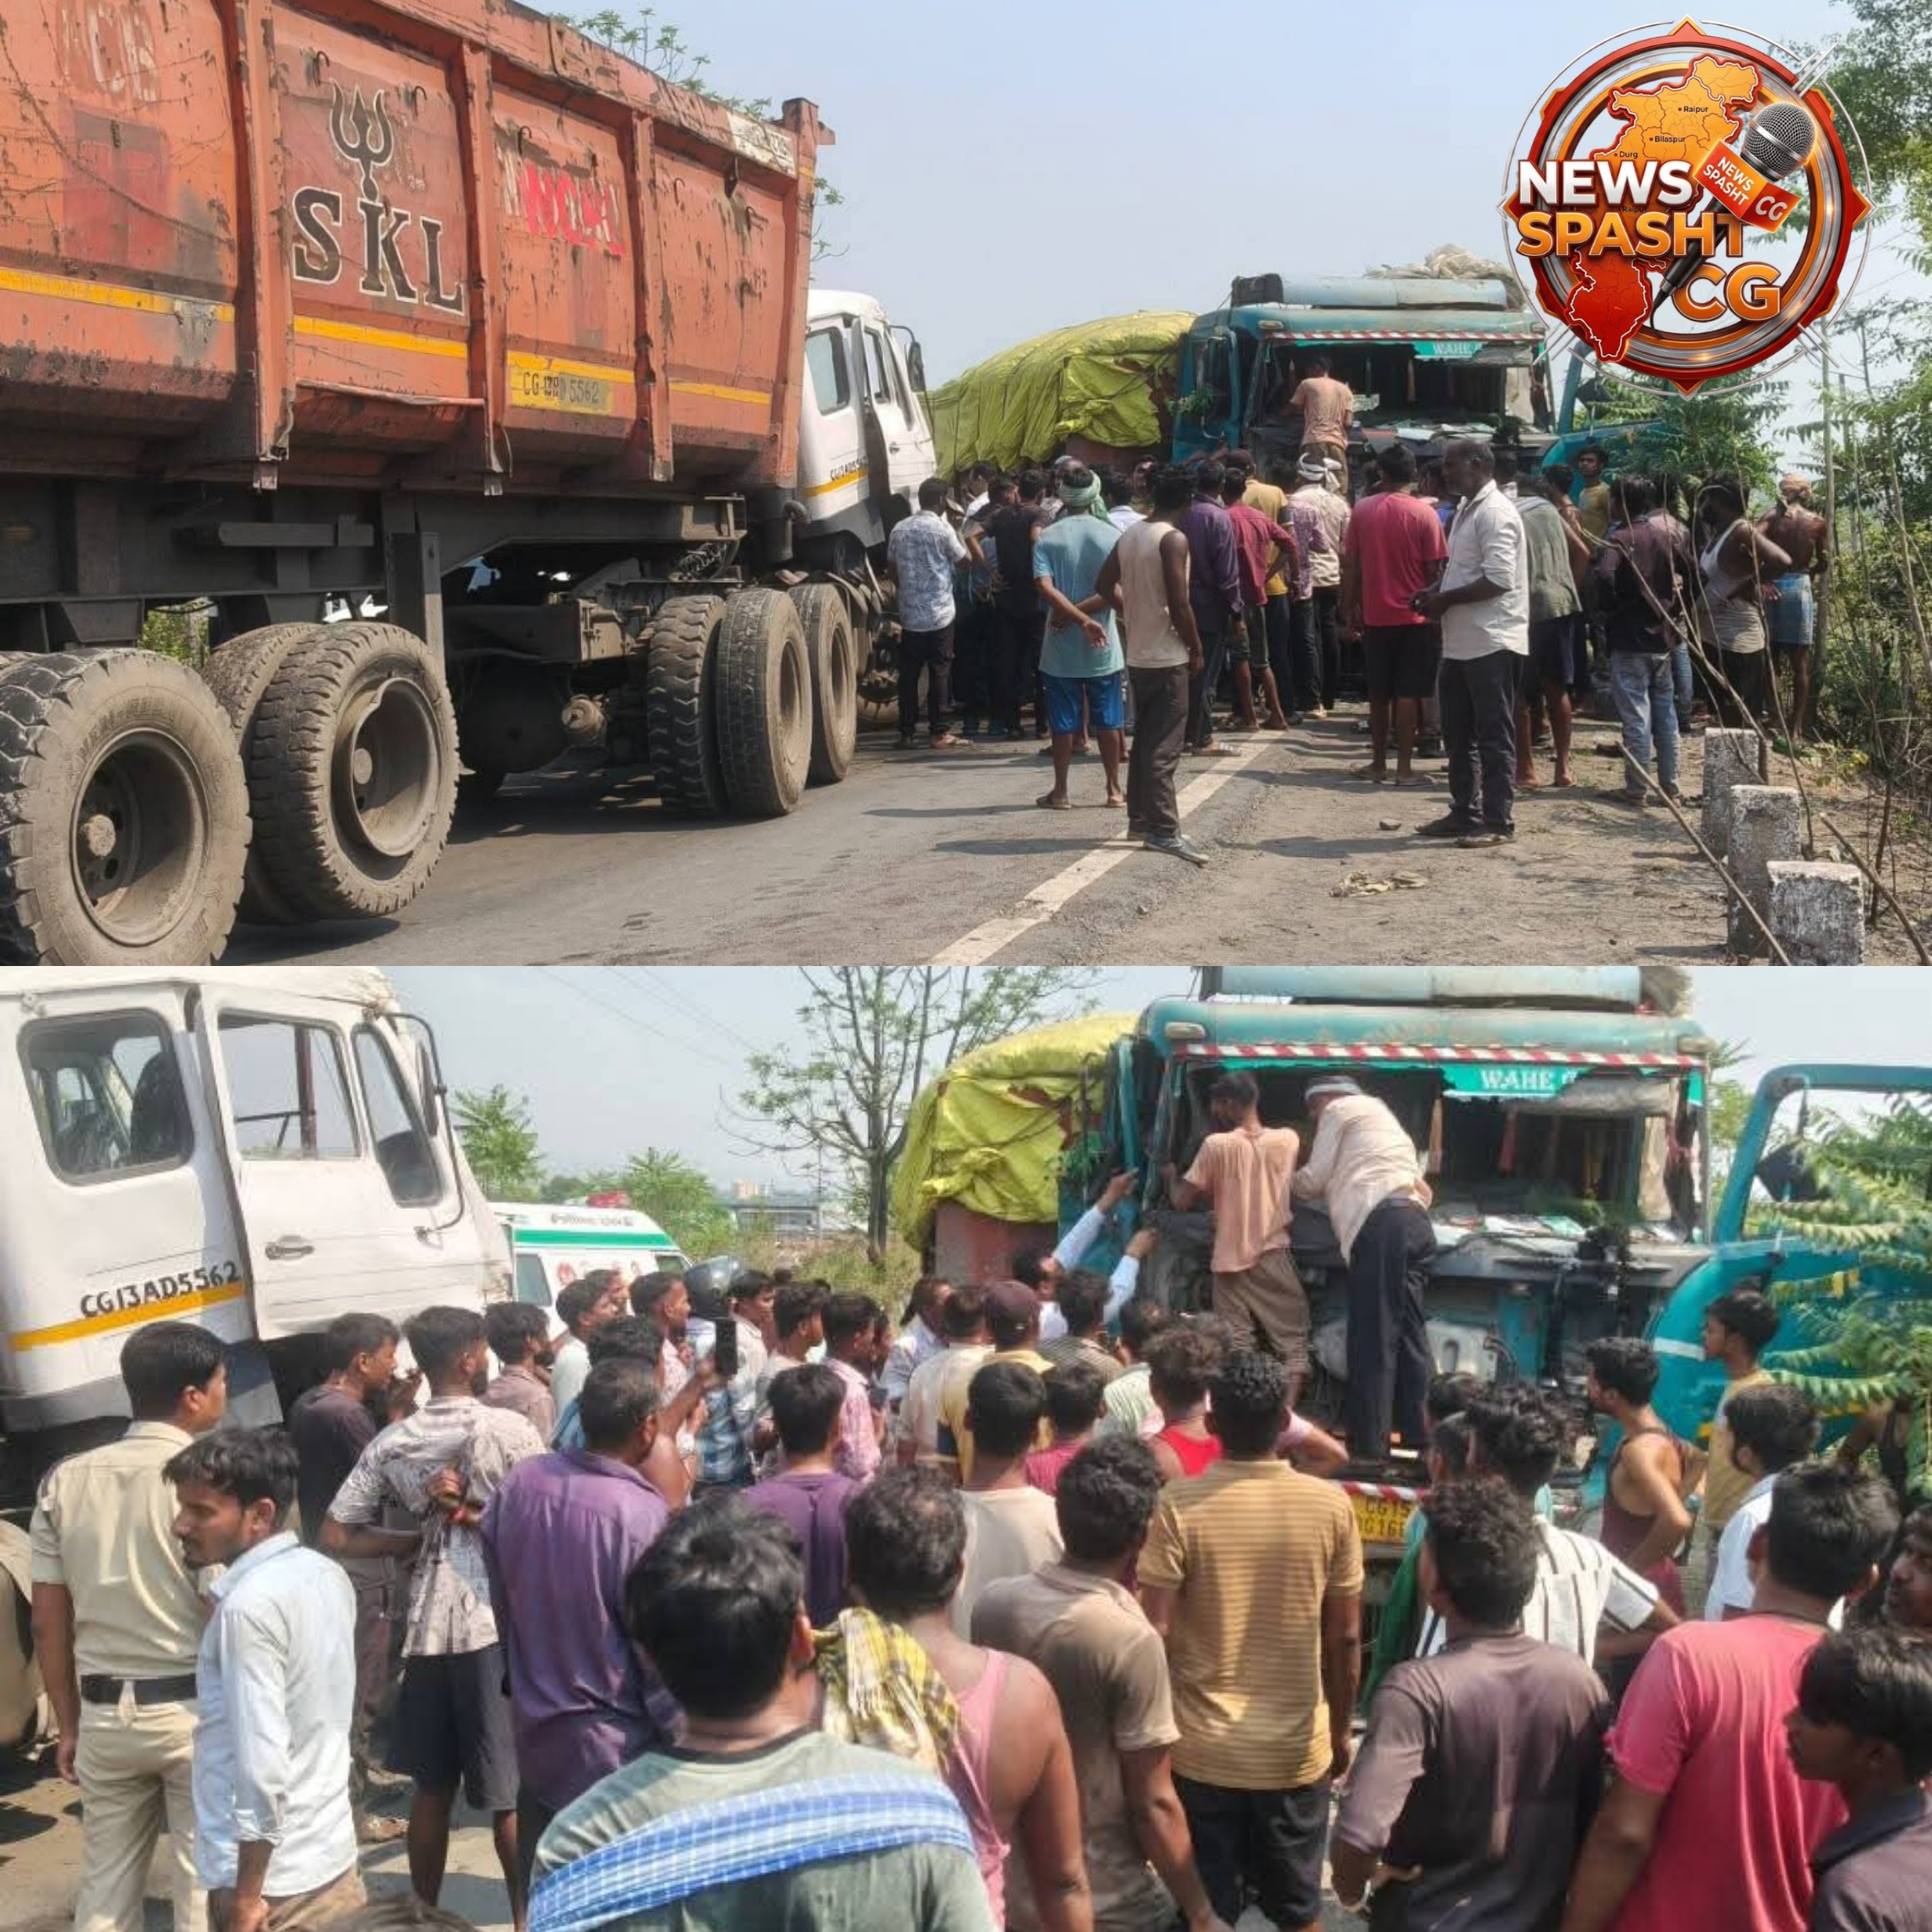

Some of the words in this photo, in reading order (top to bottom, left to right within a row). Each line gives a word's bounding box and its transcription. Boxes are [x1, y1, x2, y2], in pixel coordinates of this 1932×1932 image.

[293, 186, 464, 315] SKL
[522, 371, 539, 396] CG
[1481, 1069, 1554, 1091] WAHE
[80, 1260, 241, 1317] CG13AD5562
